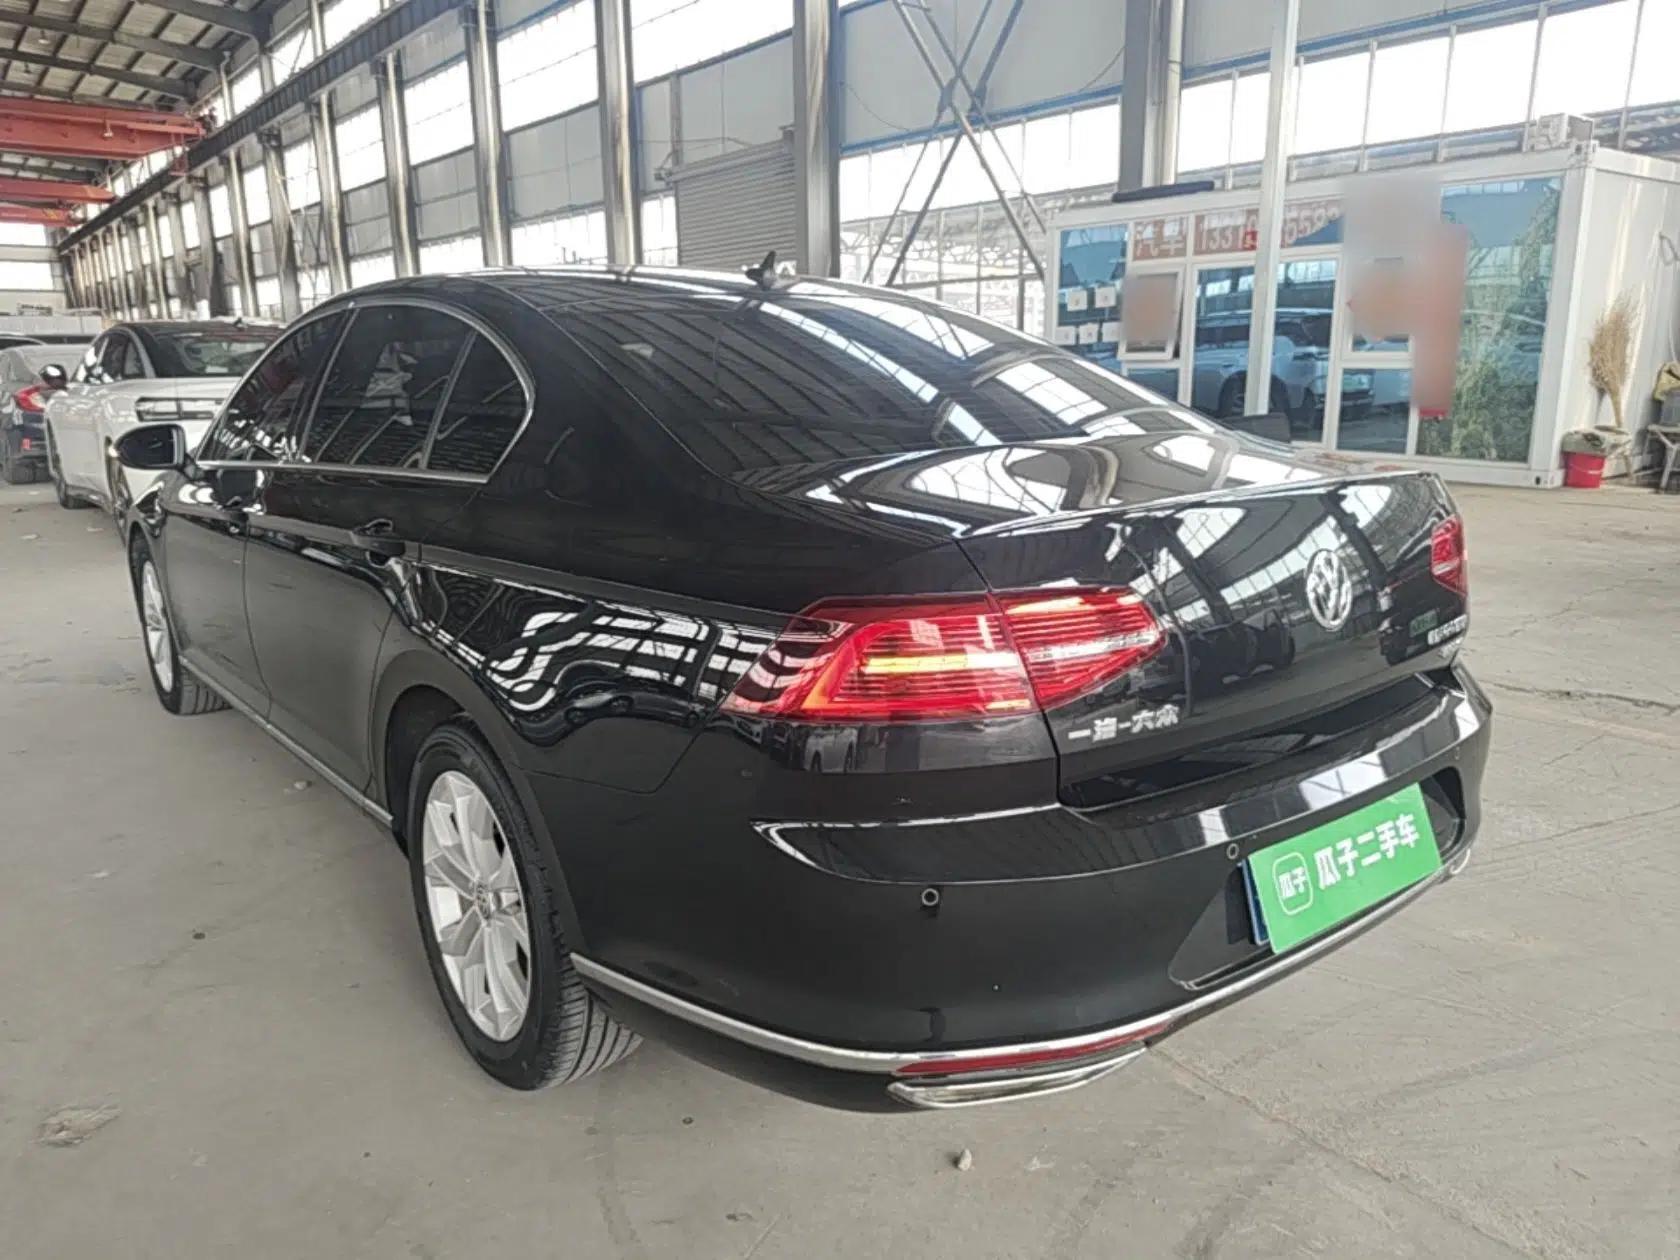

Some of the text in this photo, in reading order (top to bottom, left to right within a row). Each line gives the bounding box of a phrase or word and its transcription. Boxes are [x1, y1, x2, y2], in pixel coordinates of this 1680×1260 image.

[1313, 812, 1420, 890] 瓜子二手车
[1278, 866, 1309, 900] 瓜子
